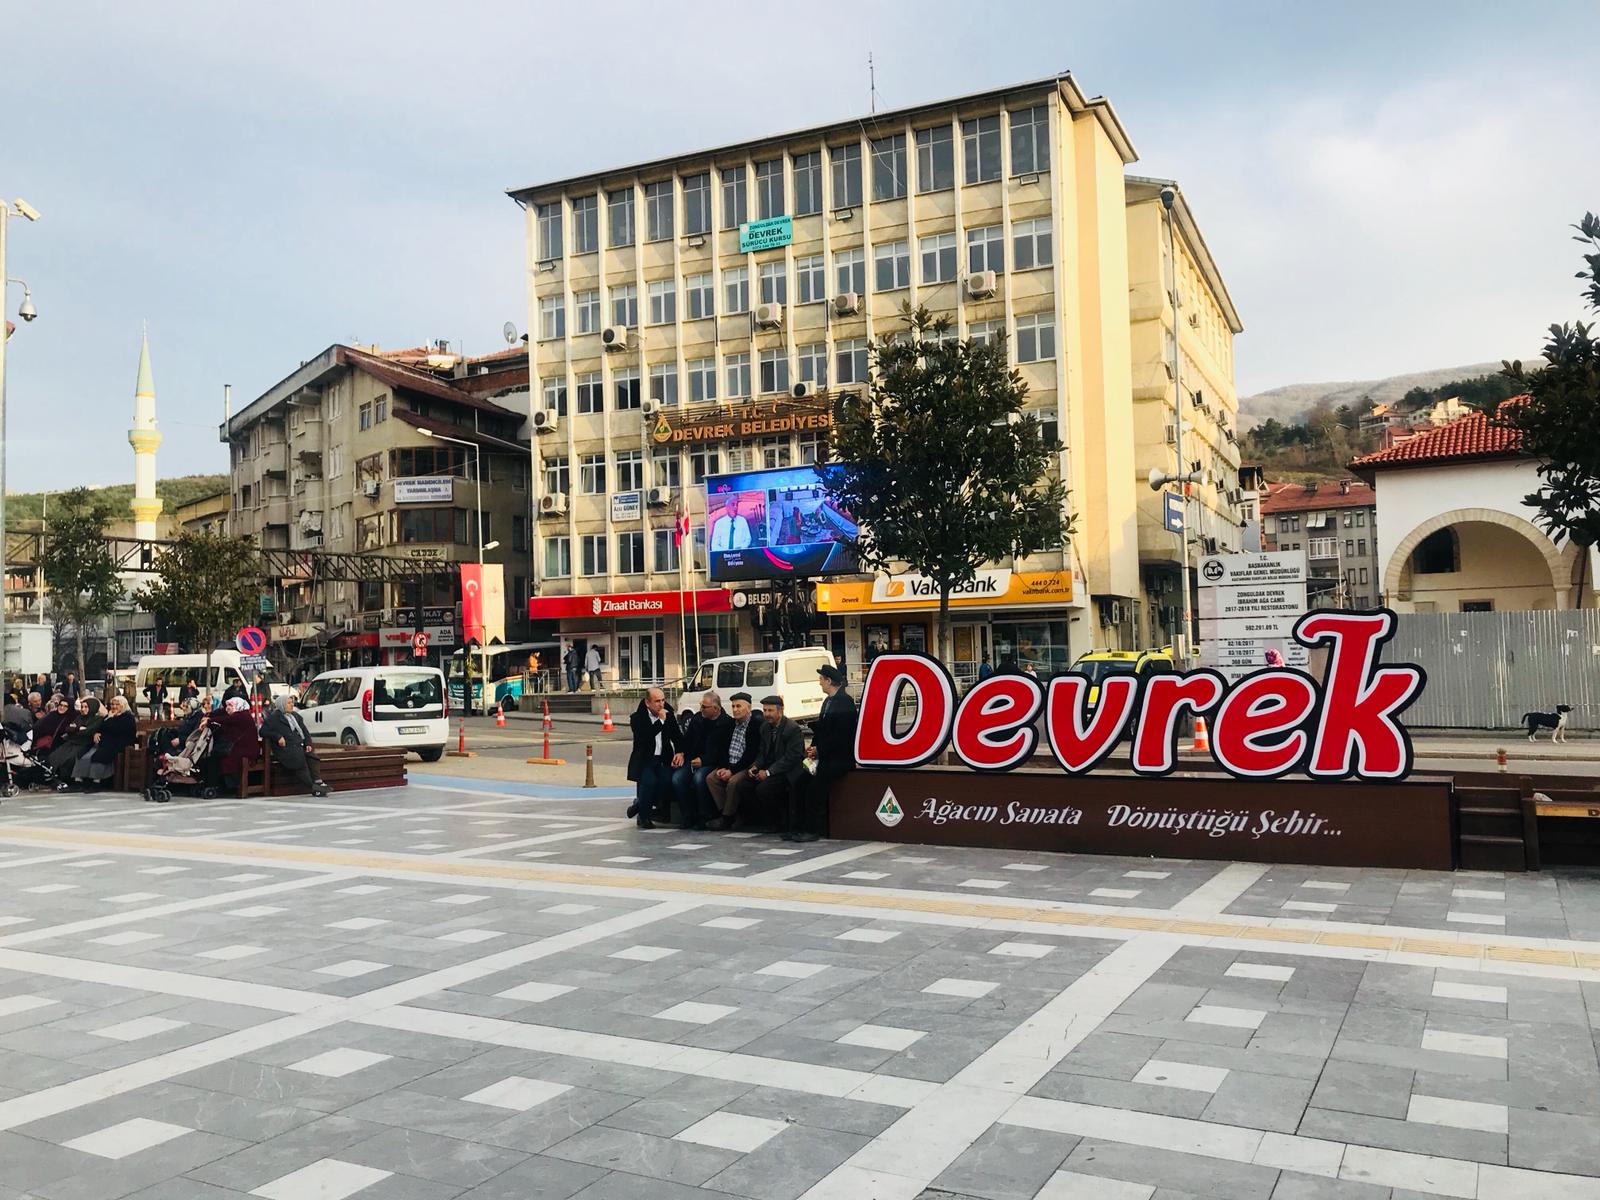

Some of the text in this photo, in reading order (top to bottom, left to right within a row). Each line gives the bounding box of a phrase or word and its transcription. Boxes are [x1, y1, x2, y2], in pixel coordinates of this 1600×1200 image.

[749, 227, 783, 239] DEVREK
[741, 237, 768, 248] SÜRÜCÜ
[769, 234, 792, 243] KURSU
[673, 411, 833, 441] DEVREK BELEDİYESİ
[911, 576, 997, 596] VakBank
[1237, 589, 1285, 598] ZONGULDAK DEVREK
[629, 599, 663, 610] Bankası
[1225, 605, 1250, 613] 2017-2018
[1260, 603, 1299, 611] RESTORASYONU
[855, 609, 1427, 783] Devrek
[914, 797, 998, 825] Ağacın
[1000, 801, 1083, 825] Sanata
[1107, 804, 1250, 838] Dönüştüğü
